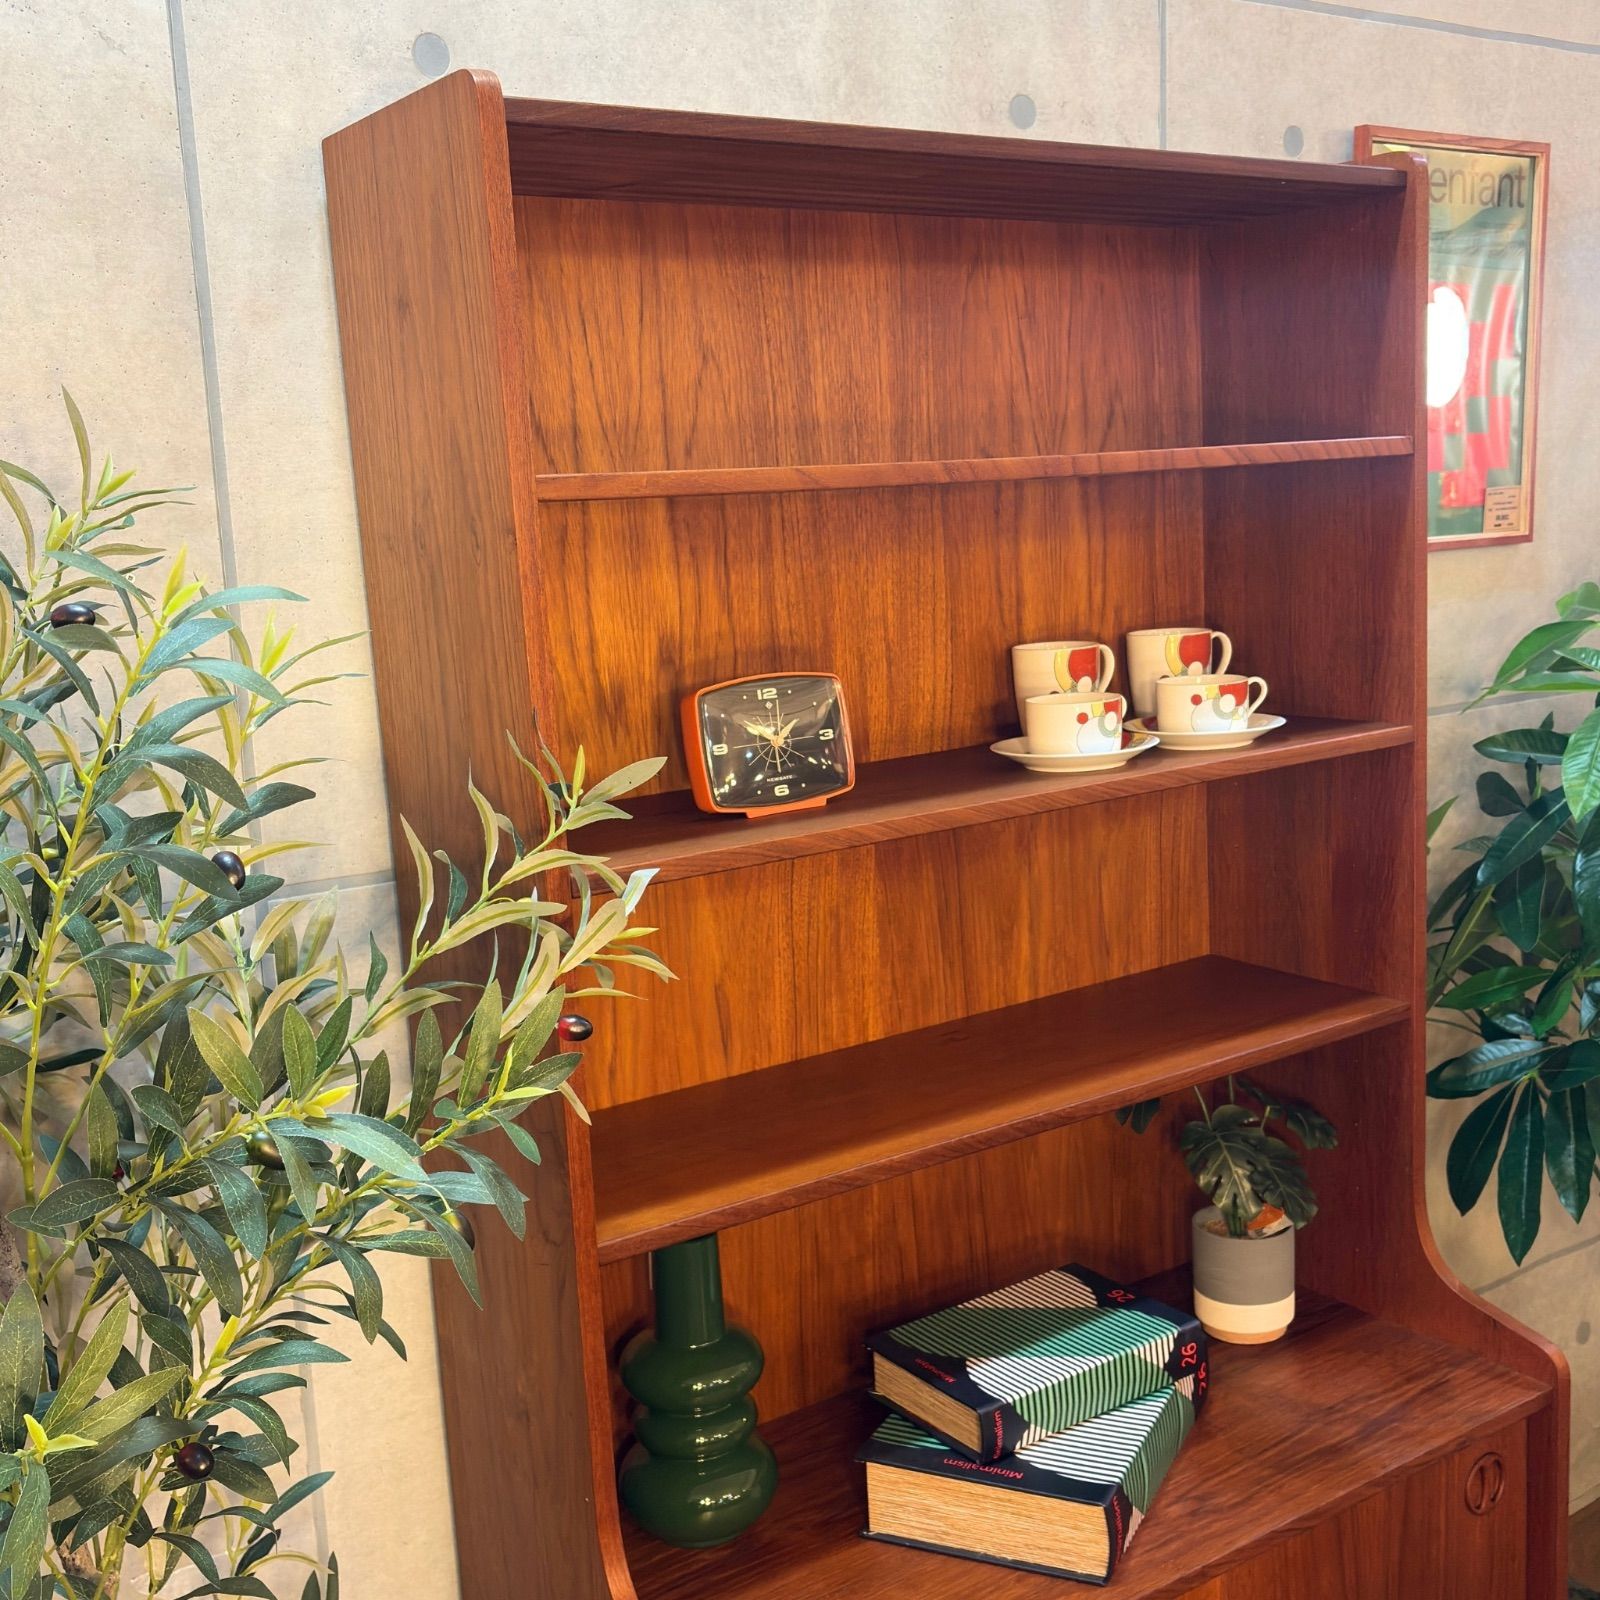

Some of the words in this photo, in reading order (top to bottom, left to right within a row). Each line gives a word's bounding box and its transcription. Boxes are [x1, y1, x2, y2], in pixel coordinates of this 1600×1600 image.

[1430, 158, 1526, 208] enfant
[757, 688, 778, 701] 12
[818, 728, 834, 741] 3
[712, 743, 729, 756] 9
[774, 785, 790, 797] 6
[1107, 1290, 1136, 1303] 26
[1181, 1343, 1197, 1367] 26
[943, 1458, 1024, 1479] Minimalism
